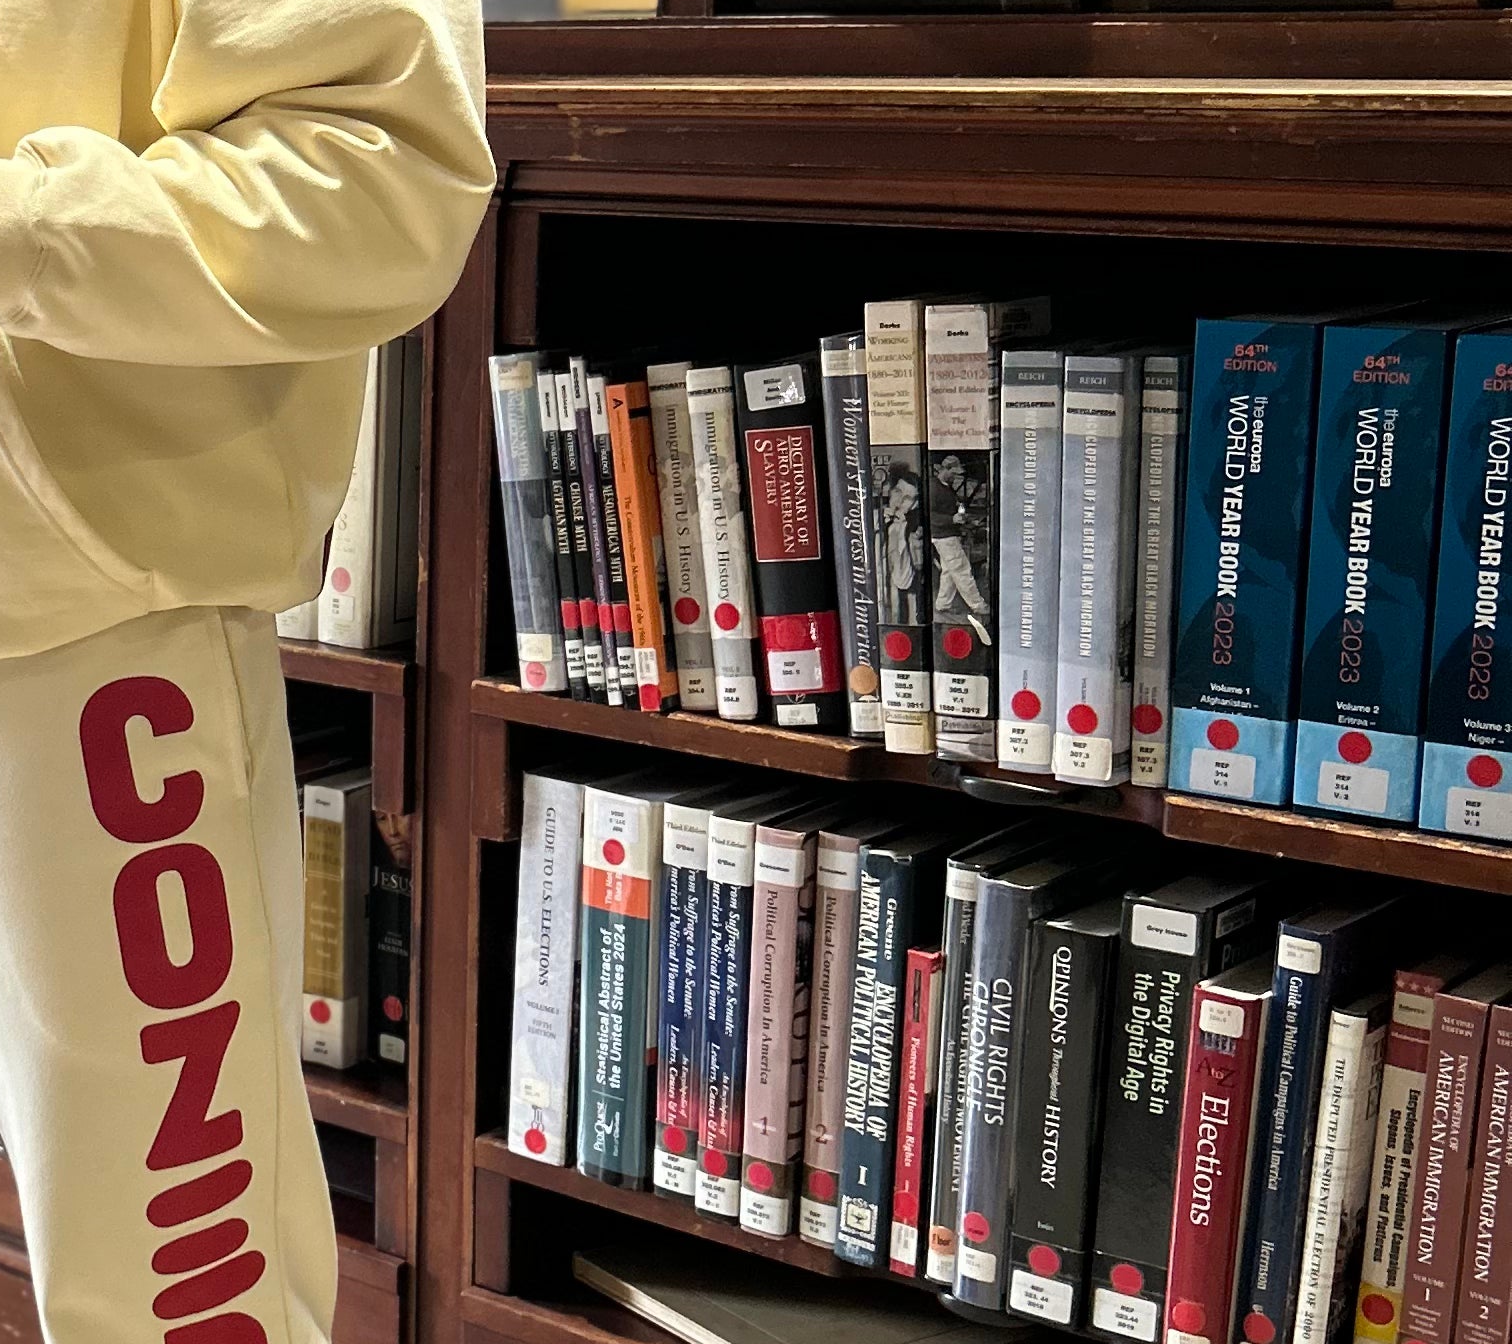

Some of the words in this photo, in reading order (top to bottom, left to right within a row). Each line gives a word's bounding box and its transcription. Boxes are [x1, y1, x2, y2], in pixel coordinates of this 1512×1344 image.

[1224, 358, 1278, 373] EDITION
[1353, 370, 1411, 384] EDITION
[1364, 355, 1400, 369] 64TH
[704, 412, 722, 493] mmigration
[776, 438, 790, 475] AFRO
[842, 396, 866, 481] Women's
[1224, 396, 1249, 480] WORLD
[1354, 407, 1379, 494] WORLD
[1484, 417, 1512, 505] WORLD
[754, 439, 778, 506] SLAVERY
[790, 436, 808, 523] DICTIONARY
[1149, 490, 1162, 502] OF
[552, 479, 567, 527] EGYPTIAN
[570, 482, 584, 521] CHINESE
[602, 484, 621, 554] MESOAMERICAN
[713, 498, 724, 511] in
[780, 479, 796, 553] AMERICAN
[843, 483, 868, 562] Progress
[1148, 506, 1161, 525] THE
[1220, 484, 1244, 536] YEAR
[1349, 499, 1373, 552] YEAR
[556, 527, 570, 554] MYTH
[575, 525, 587, 552] MYTH
[797, 527, 809, 545] OF
[1147, 529, 1160, 561] GREAT
[1480, 511, 1504, 565] YEAR
[610, 557, 624, 582] MYTH
[717, 551, 732, 601] History
[852, 565, 871, 583] in
[1146, 564, 1159, 597] BLACK
[1217, 541, 1241, 598] BOOK
[1345, 557, 1369, 614] BOOK
[1474, 570, 1500, 629] BOOK
[1144, 601, 1157, 657] MIGRATION
[1213, 602, 1235, 665] 2023
[1339, 618, 1363, 684] 2023
[1210, 682, 1243, 695] Volume
[1469, 634, 1493, 700] 2023
[1336, 701, 1371, 713] Volume
[1463, 718, 1503, 732] Volume
[1468, 733, 1497, 745] Niger
[544, 807, 557, 853] GUIDE
[543, 857, 555, 876] TO
[599, 927, 613, 942] of
[765, 890, 778, 940] Political
[824, 896, 836, 946] Political
[857, 869, 880, 962] AMERICAN
[884, 898, 897, 960] Greene
[538, 908, 553, 986] ELECTIONS
[612, 924, 626, 960] 2024
[598, 947, 612, 1007] Abstract
[612, 964, 625, 1010] States
[762, 944, 775, 1014] Corruption
[820, 950, 834, 1021] Corruption
[1050, 946, 1072, 1044] OPINIONS
[1133, 973, 1153, 1001] the
[1153, 970, 1180, 1033] Privacy
[1287, 976, 1303, 1009] Guide
[762, 1017, 772, 1030] In
[820, 1024, 830, 1037] In
[849, 964, 876, 1057] POLITICAL
[990, 978, 1012, 1035] CIVIL
[1286, 1010, 1298, 1023] to
[595, 1011, 611, 1084] Statistical
[611, 1014, 625, 1061] United
[760, 1033, 772, 1085] America
[867, 981, 897, 1107] ENCYCLOPEDIA
[966, 980, 989, 1111] CHRONICLE
[1125, 1005, 1151, 1065] Digital
[1281, 1025, 1297, 1070] Political
[611, 1065, 623, 1090] the
[817, 1040, 830, 1092] America
[984, 1045, 1008, 1125] RIGHTS
[1120, 1067, 1144, 1101] Age
[1149, 1037, 1174, 1093] Rights
[844, 1058, 868, 1134] HISTORY
[1149, 1096, 1169, 1115] in
[1273, 1071, 1293, 1130] Campaigns
[1431, 1050, 1454, 1144] AMERICAN
[1449, 1054, 1468, 1135] ENCYCLOPEDIA
[1486, 1064, 1509, 1157] AMERICAN
[866, 1116, 887, 1141] OF
[1040, 1104, 1061, 1189] HISTORY
[1273, 1132, 1285, 1143] in
[1385, 1108, 1401, 1150] Slogans,
[1449, 1137, 1459, 1152] OF
[1190, 1092, 1230, 1226] Elections
[1268, 1145, 1284, 1190] America
[1381, 1154, 1395, 1189] Issues,
[1380, 1193, 1391, 1213] and
[1417, 1146, 1444, 1264] IMMIGRATION
[1473, 1161, 1500, 1283] IMMIGRATION
[1373, 1214, 1389, 1263] Platforms
[1257, 1240, 1275, 1290] Herrnson
